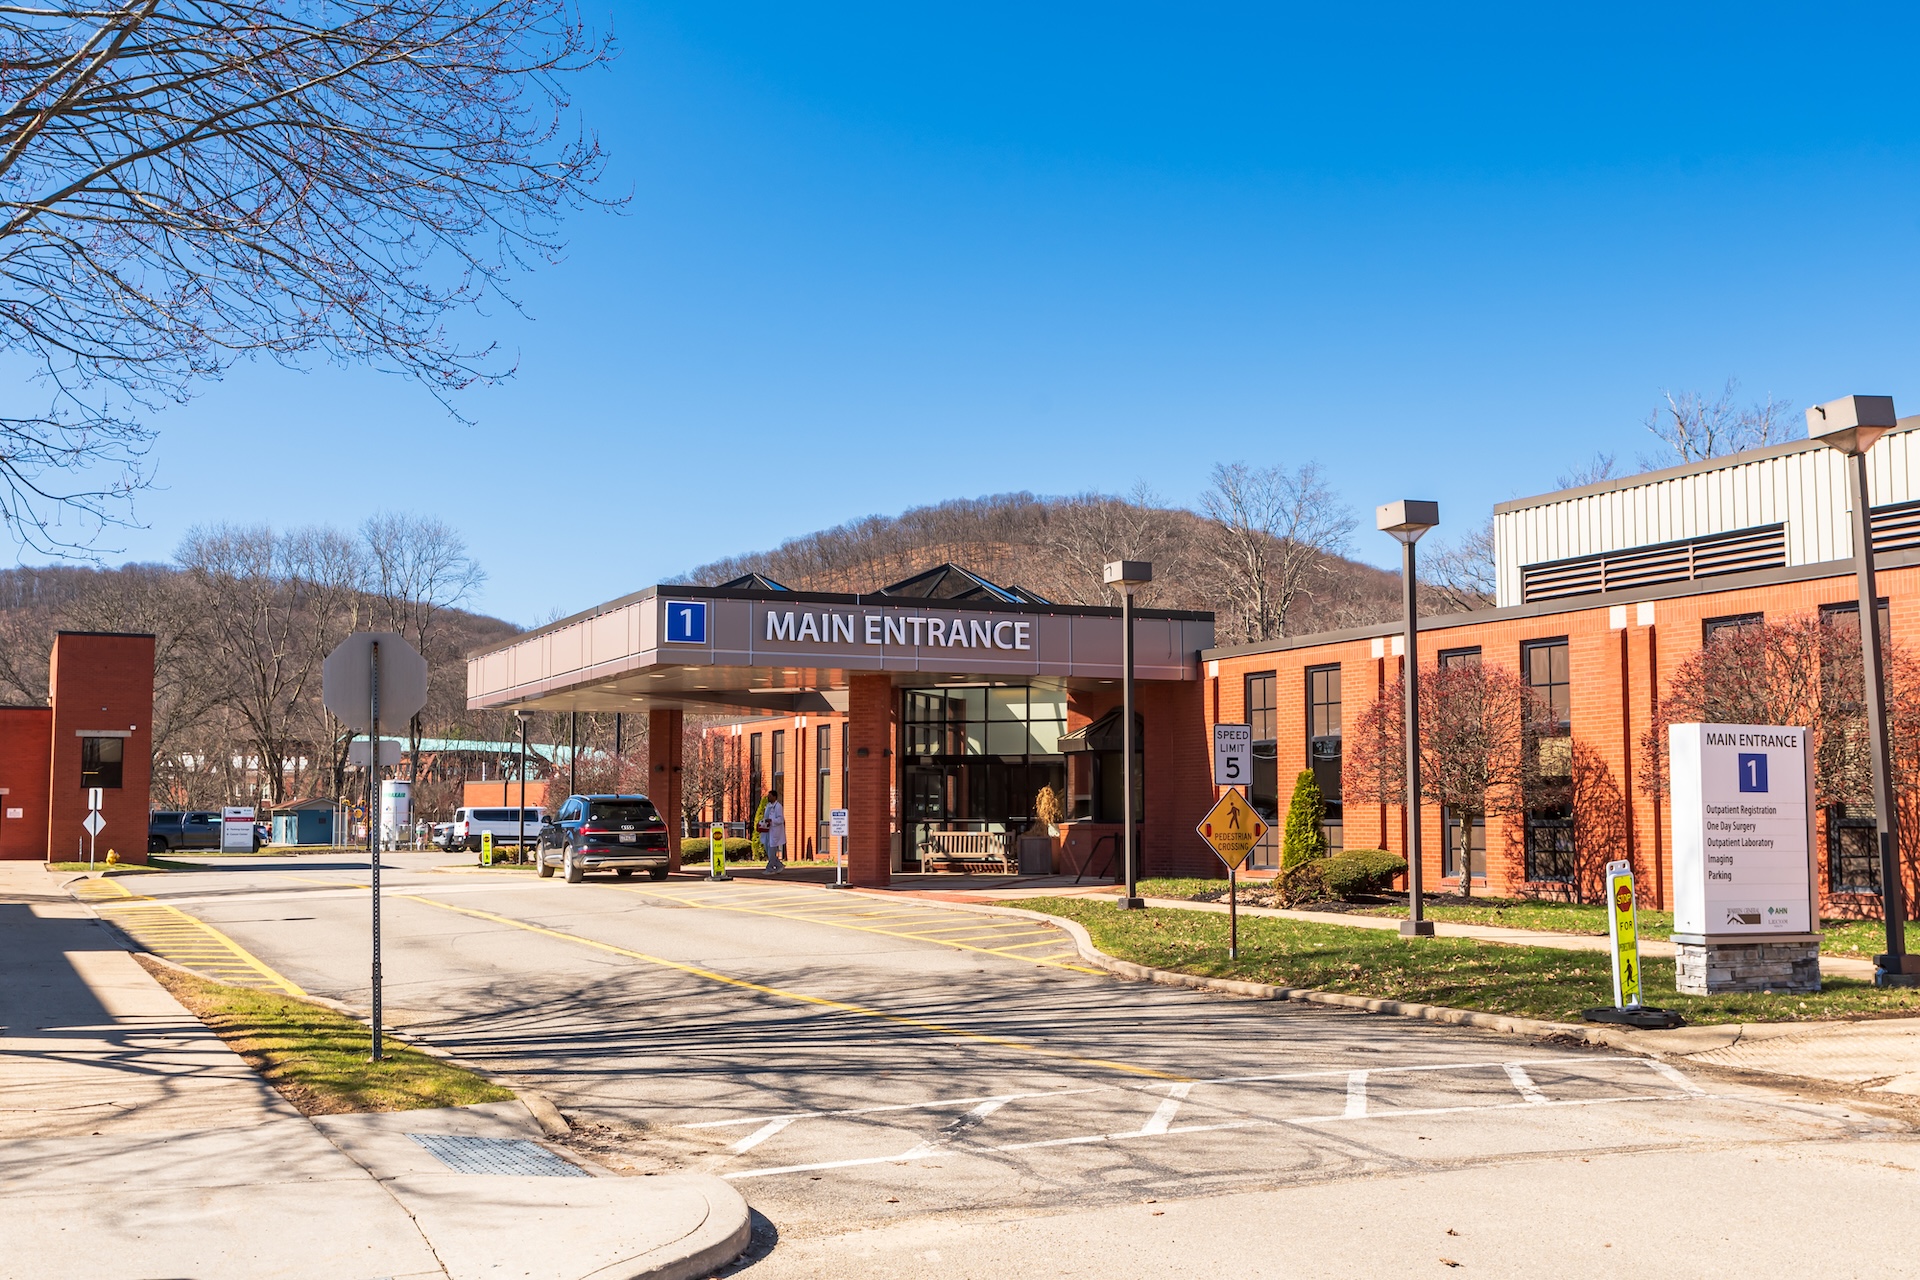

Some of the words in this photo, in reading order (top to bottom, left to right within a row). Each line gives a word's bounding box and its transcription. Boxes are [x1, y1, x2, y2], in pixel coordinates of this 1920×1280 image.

[679, 608, 692, 637] 1
[766, 610, 855, 643] MAIN
[864, 615, 1031, 650] ENTRANCE
[1217, 730, 1249, 740] SPEED
[1706, 732, 1736, 746] MAIN
[1739, 734, 1798, 748] ENTRANCE
[1220, 743, 1245, 753] LIMIT
[1226, 757, 1240, 779] 5
[1747, 759, 1757, 788] 1
[1706, 804, 1740, 815] Outpatient
[1740, 805, 1777, 816] Registration
[1706, 821, 1719, 830] One
[1720, 821, 1732, 832] Day
[1732, 821, 1756, 833] Surgery
[1214, 832, 1252, 841] PEDESTRIAN
[1217, 842, 1249, 851] CROSSING
[1707, 837, 1740, 848] Outpatient
[1741, 838, 1774, 849] Laboratory
[1707, 854, 1734, 865] Imaging
[1708, 870, 1732, 882] Parking
[1617, 893, 1632, 904] STOP
[1620, 920, 1633, 931] FOR
